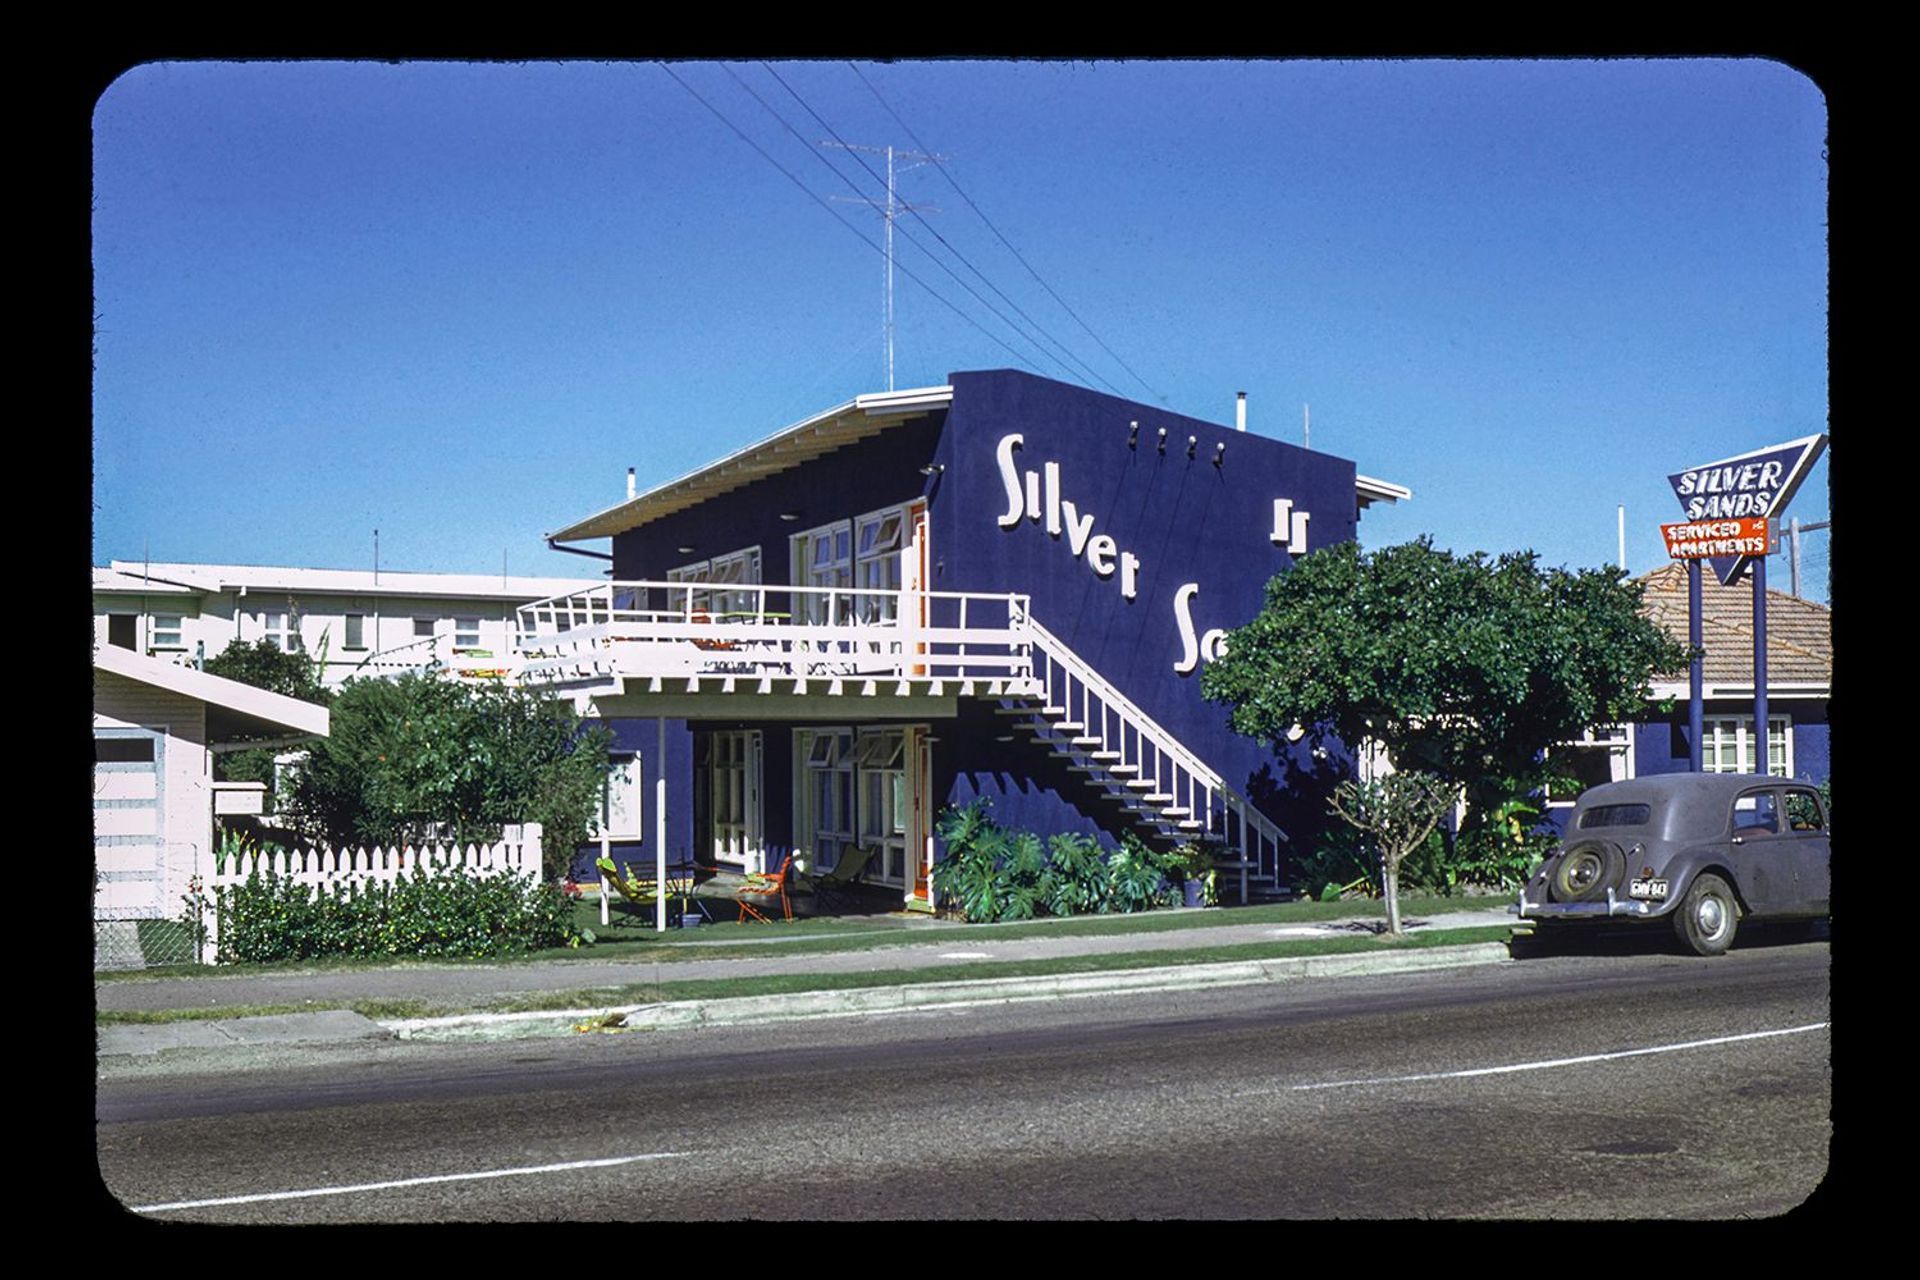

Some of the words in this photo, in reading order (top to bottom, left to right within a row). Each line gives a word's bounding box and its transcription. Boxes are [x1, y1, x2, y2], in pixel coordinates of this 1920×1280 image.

[1677, 461, 1782, 495] SILVER
[996, 433, 1140, 599] Silver
[1686, 492, 1771, 520] SANDS
[1667, 522, 1741, 540] SERVICED
[1670, 537, 1764, 557] APARTMENTS
